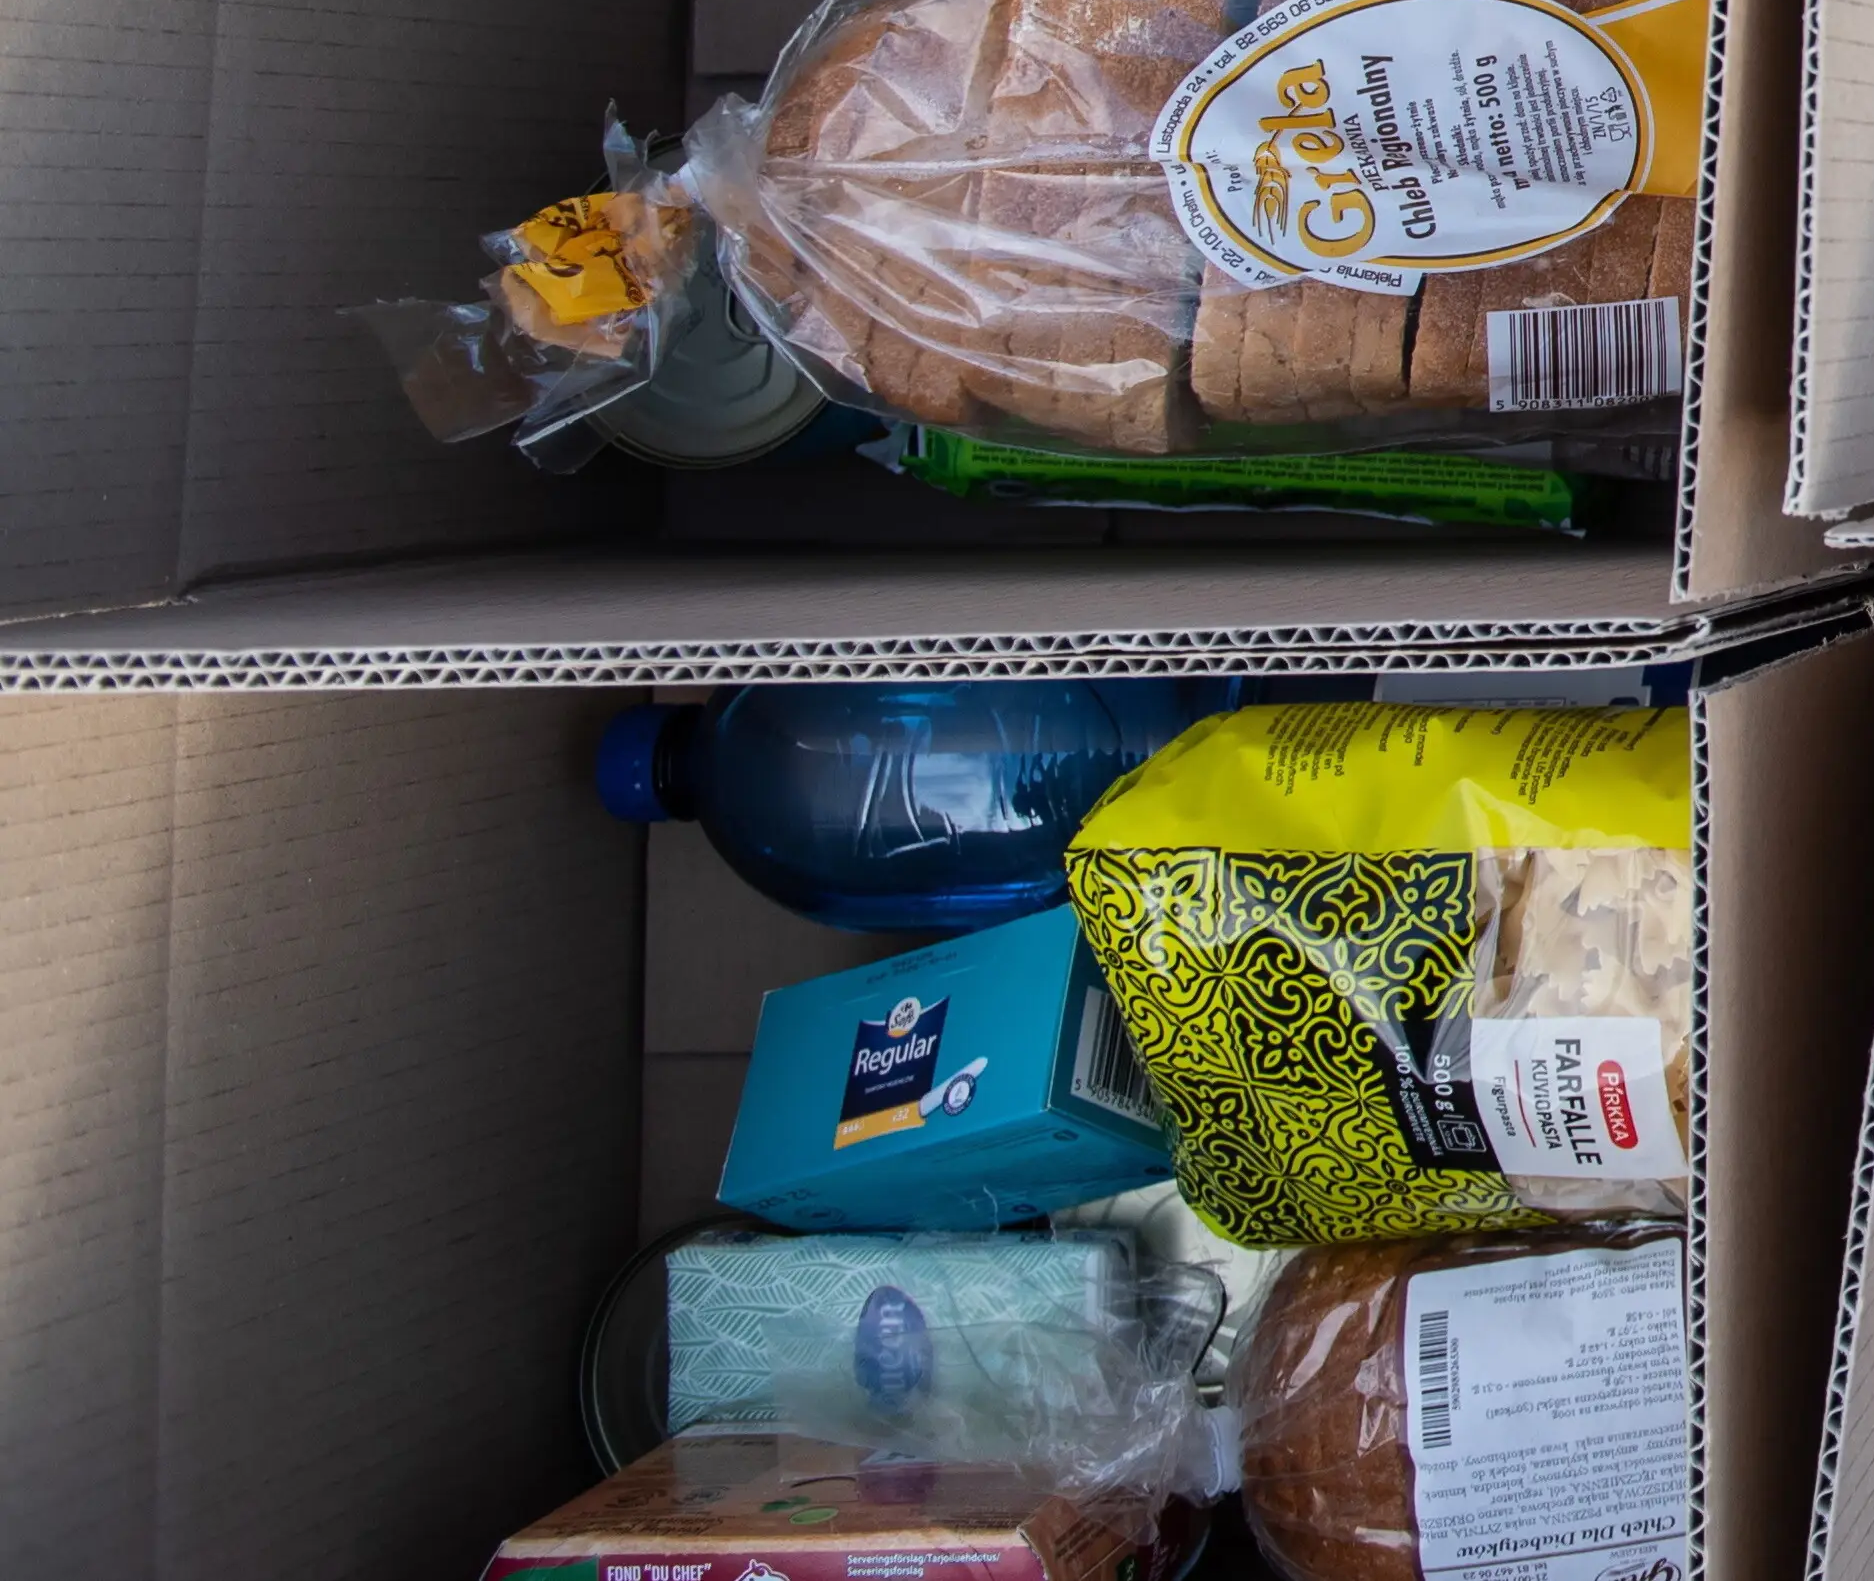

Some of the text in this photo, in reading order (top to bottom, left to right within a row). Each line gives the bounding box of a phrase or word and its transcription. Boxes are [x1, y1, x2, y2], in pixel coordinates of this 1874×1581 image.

[1156, 92, 1191, 153] Listopada
[1187, 75, 1207, 94] 24
[1235, 29, 1260, 51] 82
[1255, 16, 1290, 38] 563
[1289, 0, 1315, 19] 06
[1473, 55, 1515, 166] netto: 500 g
[1260, 59, 1377, 259] Grela
[1392, 172, 1438, 241] Chleb
[1335, 261, 1403, 291] Piekarnia
[1493, 394, 1587, 412] 5 908311
[853, 1031, 938, 1077] Regular
[1393, 1044, 1411, 1076] 100
[1433, 1053, 1454, 1098] 500
[1492, 1075, 1518, 1138] Figurpasta
[1530, 1058, 1564, 1151] KUVIOPASTA
[1554, 1037, 1603, 1167] FARFALLE
[1455, 1513, 1676, 1565] Chleb Dla Diabetyków
[606, 1564, 641, 1581] FOND
[1493, 1565, 1514, 1577] 467
